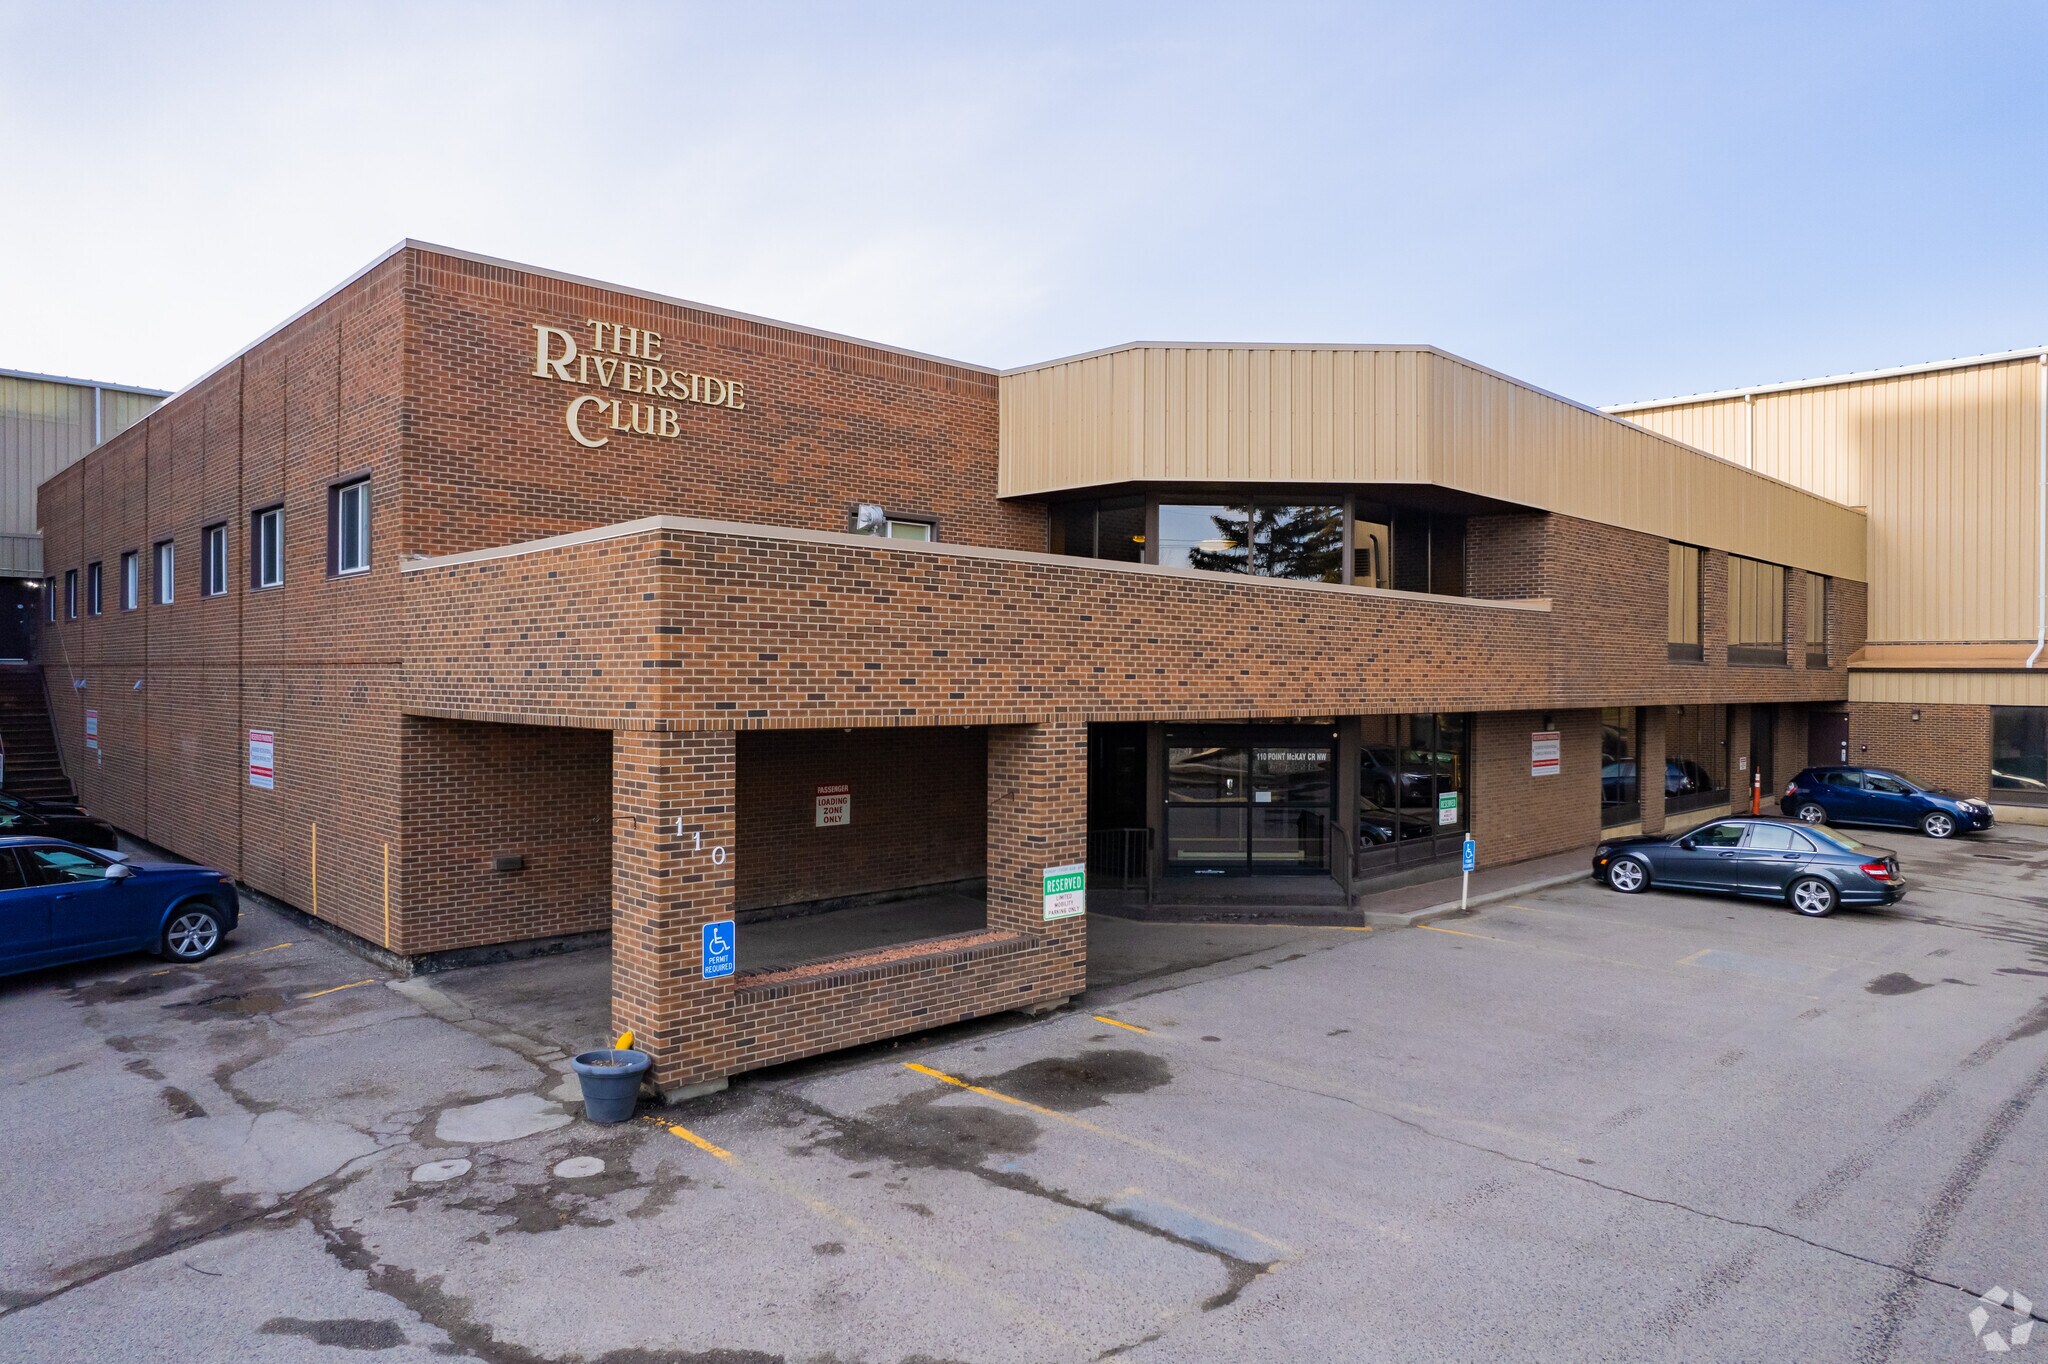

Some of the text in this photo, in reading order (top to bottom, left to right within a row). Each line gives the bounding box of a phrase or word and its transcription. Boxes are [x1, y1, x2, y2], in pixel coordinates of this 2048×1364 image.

[586, 319, 664, 362] THE
[531, 324, 746, 410] RIVERSIDE
[566, 395, 681, 448] CLUB
[1257, 752, 1327, 761] 110 POINT McKAY CR NW
[817, 785, 849, 794] PASSENGER
[818, 797, 848, 806] LOADING
[823, 806, 843, 815] ZONE
[823, 815, 843, 824] ONLY
[1046, 876, 1082, 893] RESERVED
[1055, 893, 1073, 902] LIMITED
[1054, 900, 1074, 909] MOBILITY
[1047, 908, 1067, 917] PARKING
[708, 954, 729, 965] PERMIT
[704, 962, 733, 974] REQUIRED
